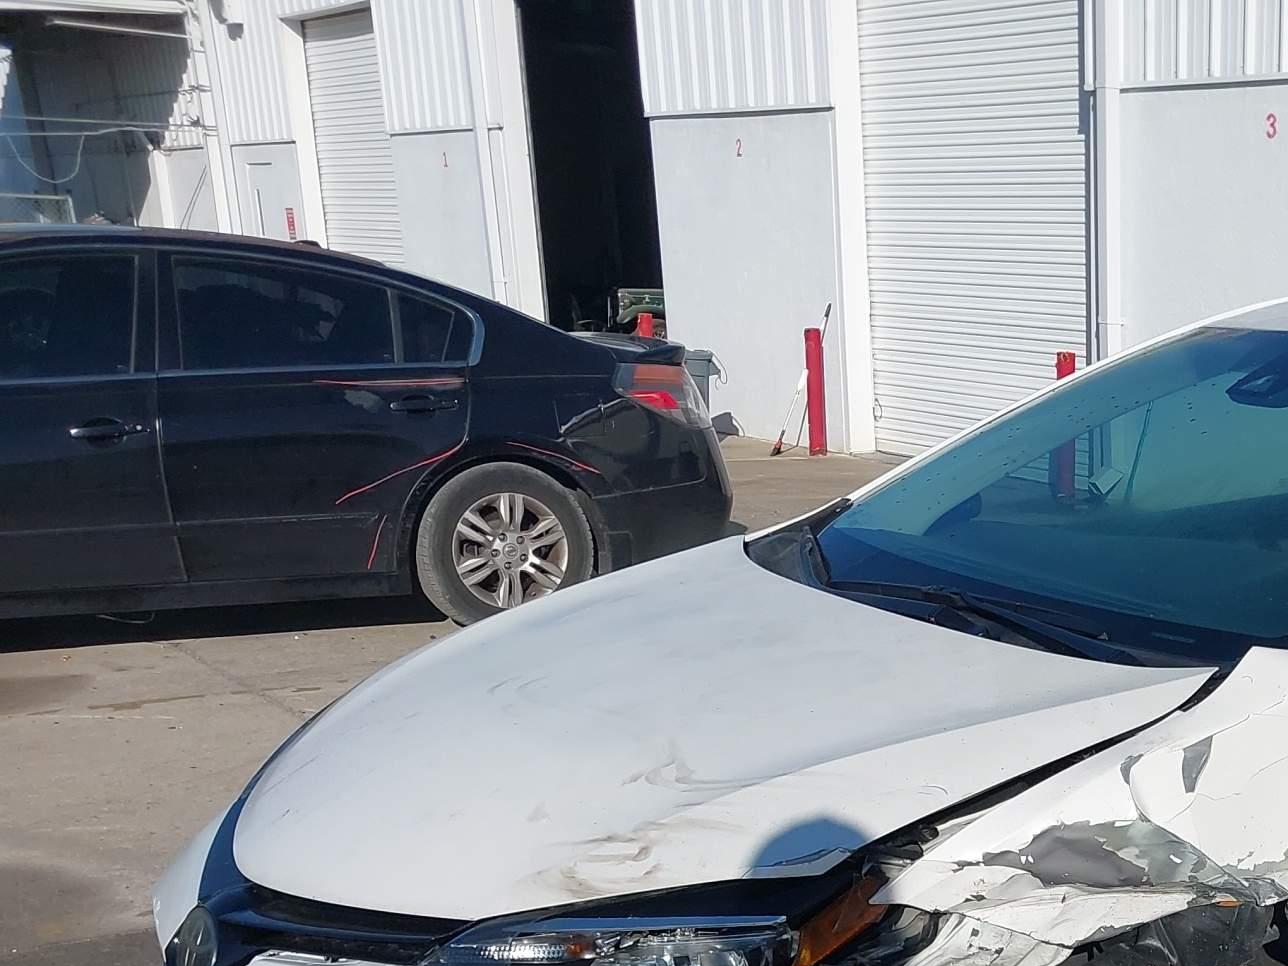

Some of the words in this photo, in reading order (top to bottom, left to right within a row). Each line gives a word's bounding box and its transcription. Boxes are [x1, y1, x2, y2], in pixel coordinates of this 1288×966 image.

[1266, 112, 1277, 139] 3
[735, 138, 742, 158] 2
[442, 151, 449, 168] 1
